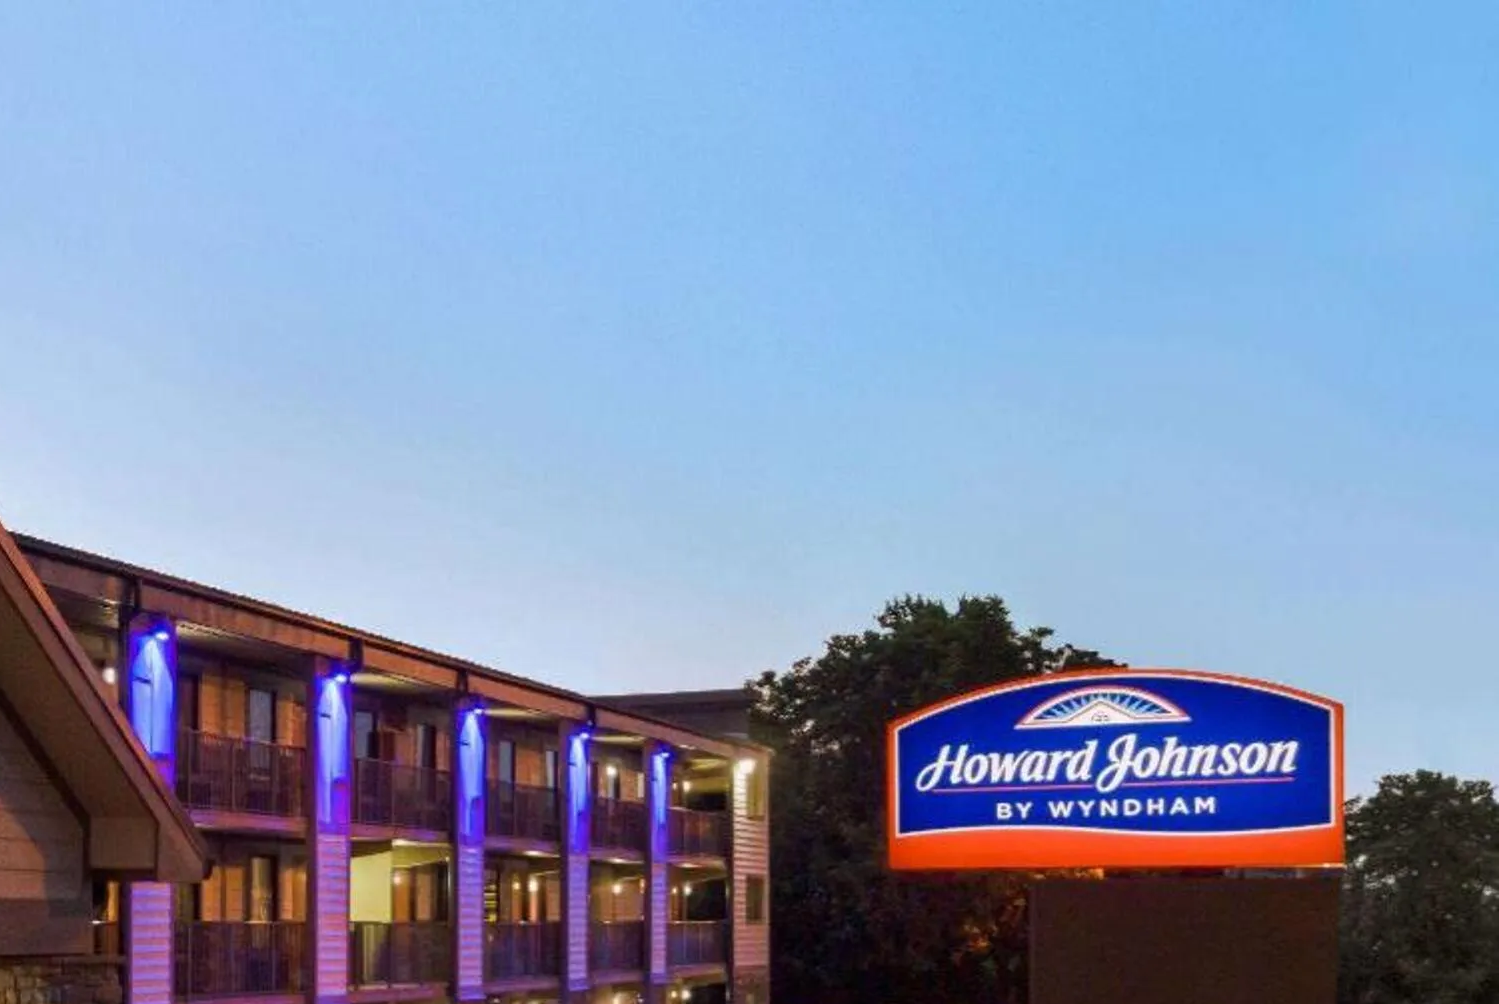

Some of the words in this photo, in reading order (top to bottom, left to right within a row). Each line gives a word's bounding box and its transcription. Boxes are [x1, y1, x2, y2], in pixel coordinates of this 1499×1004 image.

[915, 742, 1099, 792] Howard
[1097, 733, 1299, 793] Johnson
[996, 802, 1034, 820] BY
[1048, 797, 1217, 818] WYNDHAM
